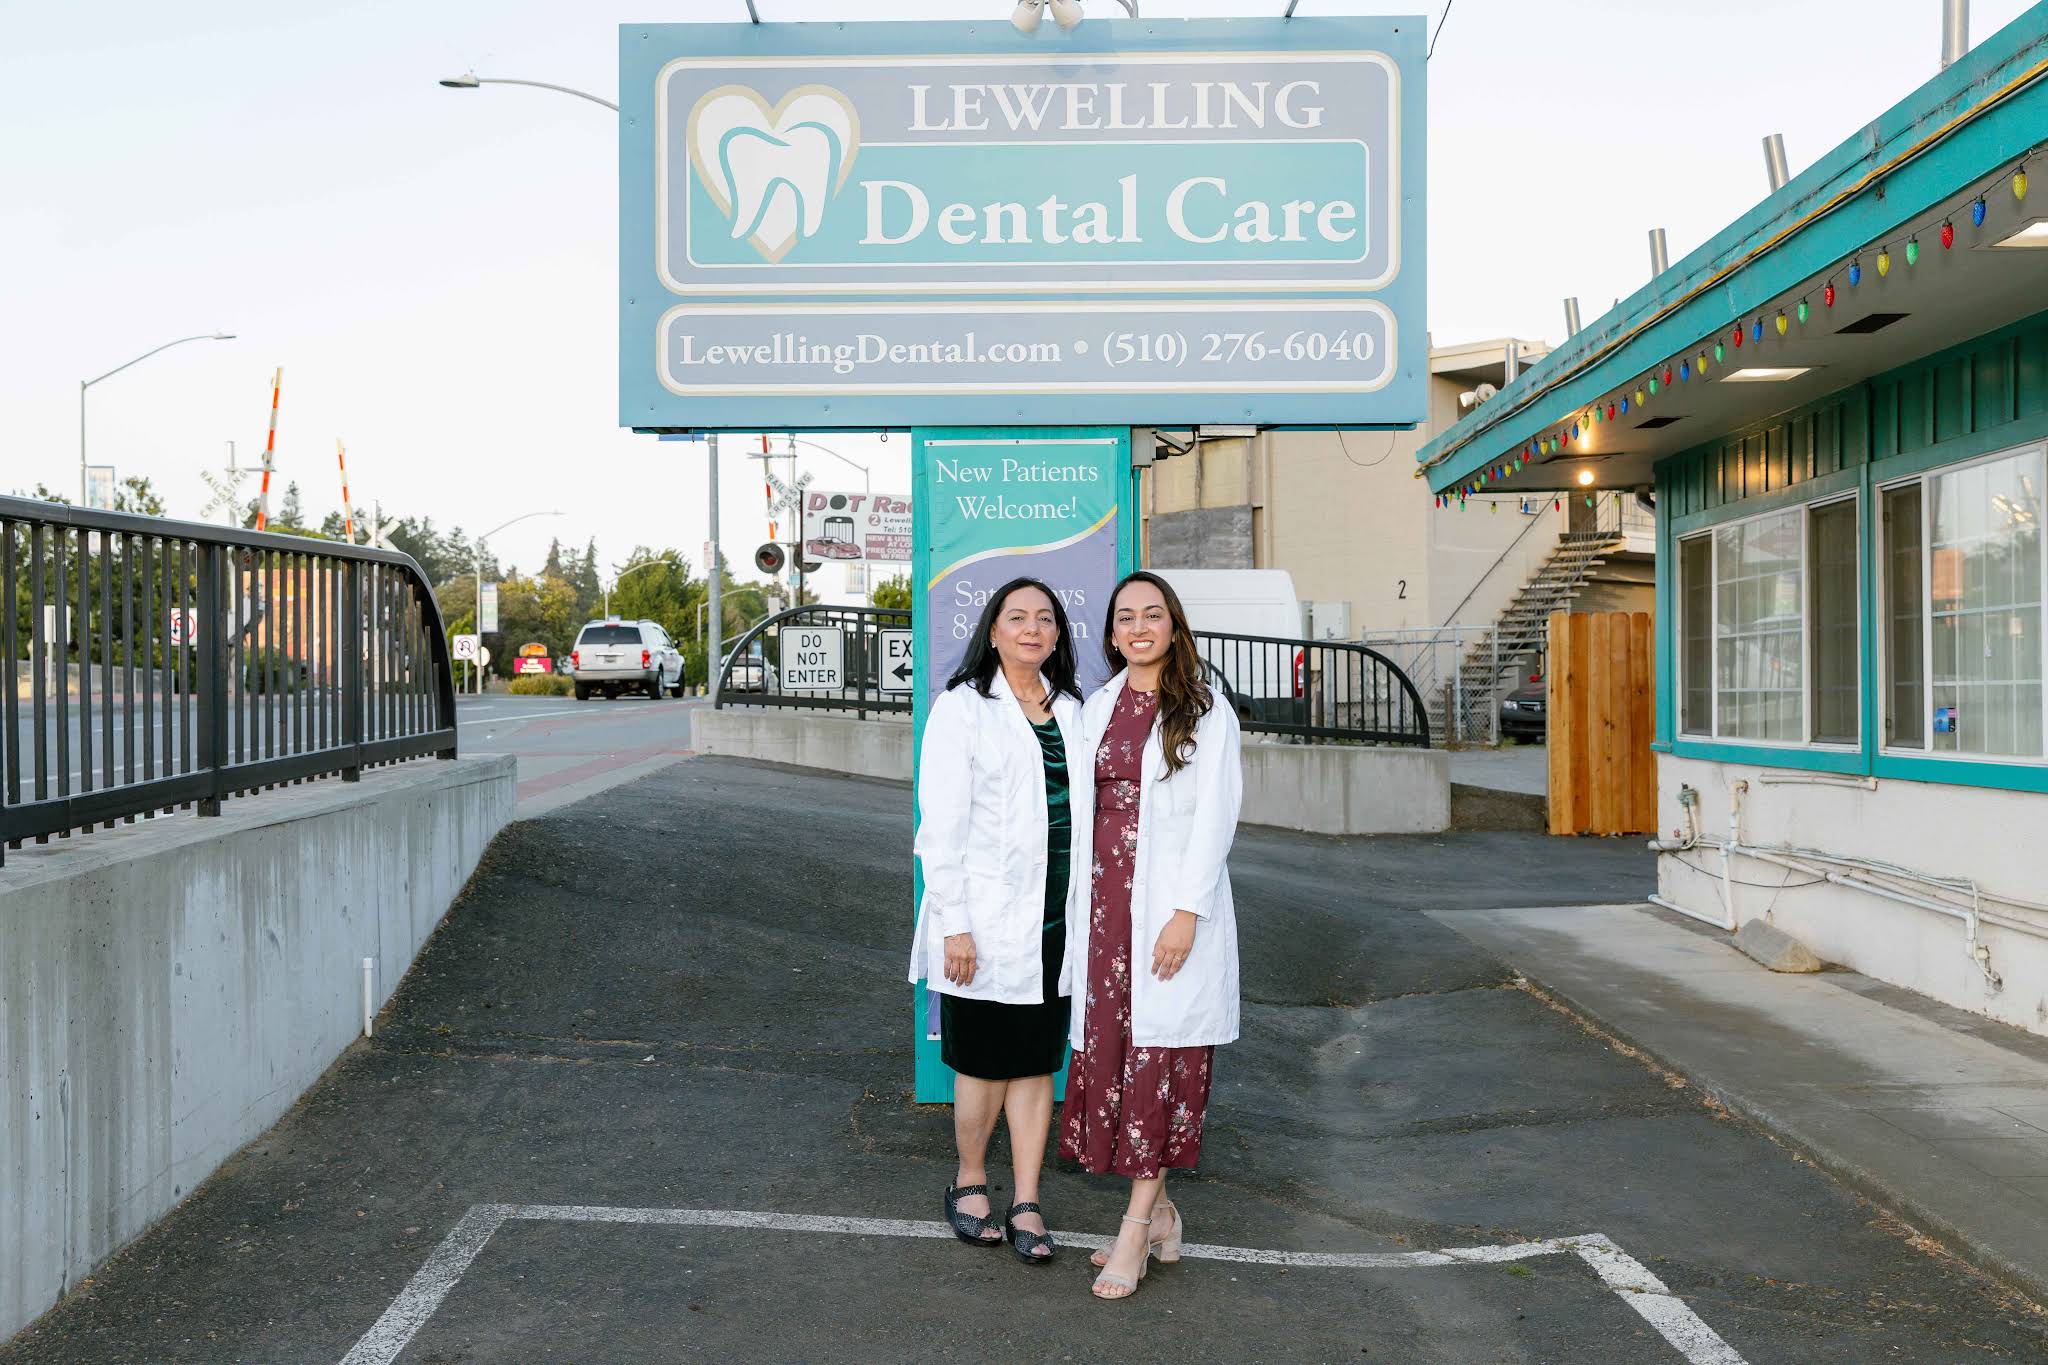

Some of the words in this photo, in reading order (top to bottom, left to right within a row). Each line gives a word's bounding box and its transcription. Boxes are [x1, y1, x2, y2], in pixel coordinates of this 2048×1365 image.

[907, 80, 1325, 132] LEWELLING
[858, 173, 1144, 245] Dental
[1165, 176, 1358, 243] Care
[679, 332, 1062, 374] LewellingDental.com
[1103, 331, 1188, 367] (510)
[1200, 329, 1375, 364] 276-6040
[935, 459, 993, 483] New
[1001, 458, 1099, 483] Patients
[955, 495, 1078, 520] Welcome!
[869, 513, 880, 526] 2
[1398, 580, 1407, 600] 2
[801, 635, 822, 648] DO
[797, 652, 827, 666] NOT
[788, 669, 836, 683] ENTER
